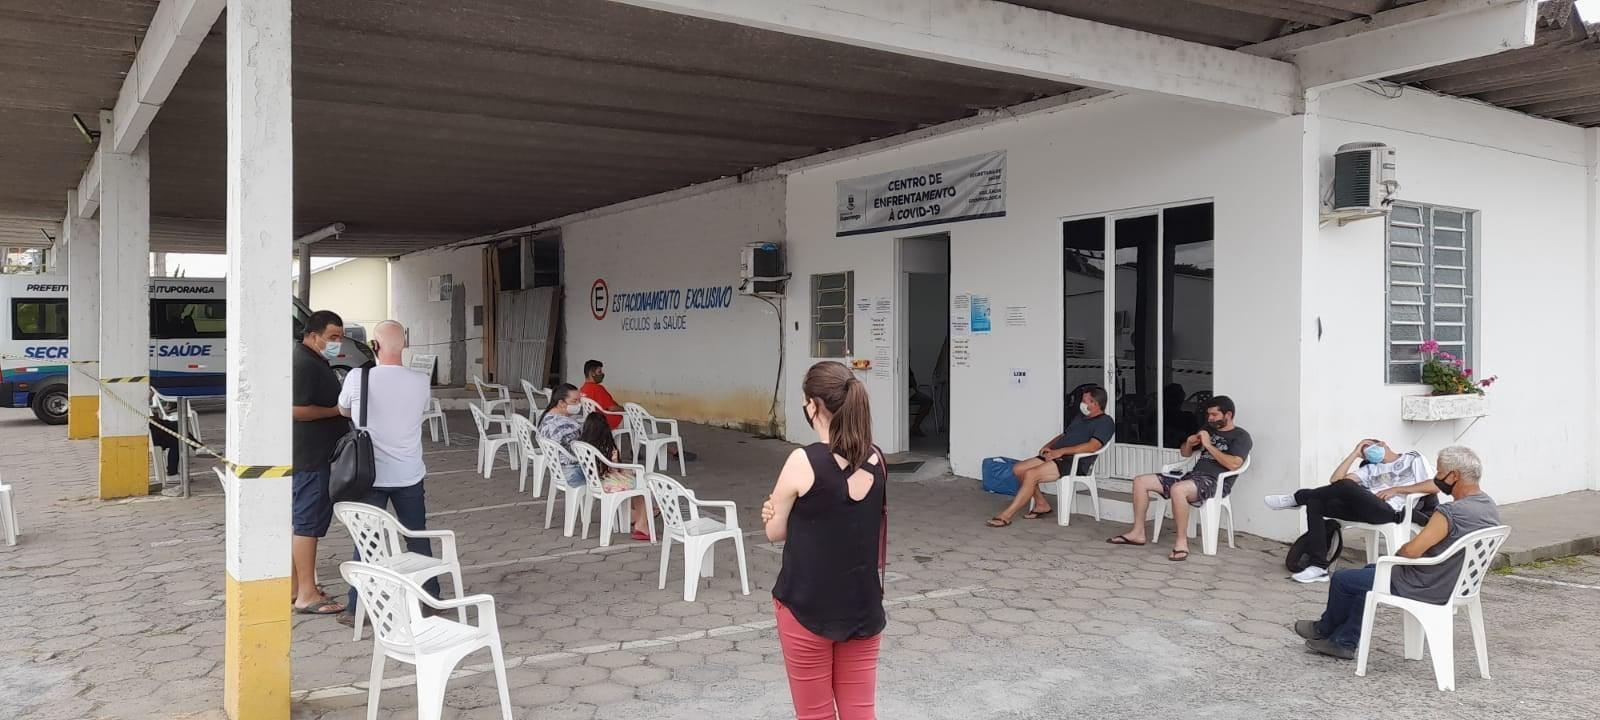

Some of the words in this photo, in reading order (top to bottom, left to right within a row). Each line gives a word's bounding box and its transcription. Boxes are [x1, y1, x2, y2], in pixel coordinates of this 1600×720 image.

[888, 176, 926, 191] CENTRO
[929, 173, 942, 185] DE
[874, 186, 956, 208] ENFRENTAMENTO
[897, 204, 940, 220] COVID-19
[26, 284, 68, 292] PREFEIT
[595, 287, 604, 311] E
[612, 289, 680, 312] ESTACIONAMENTO
[685, 286, 733, 309] EXCLUSIVO
[653, 318, 661, 330] da
[24, 346, 68, 359] SECR
[158, 342, 212, 357] SAÚDE
